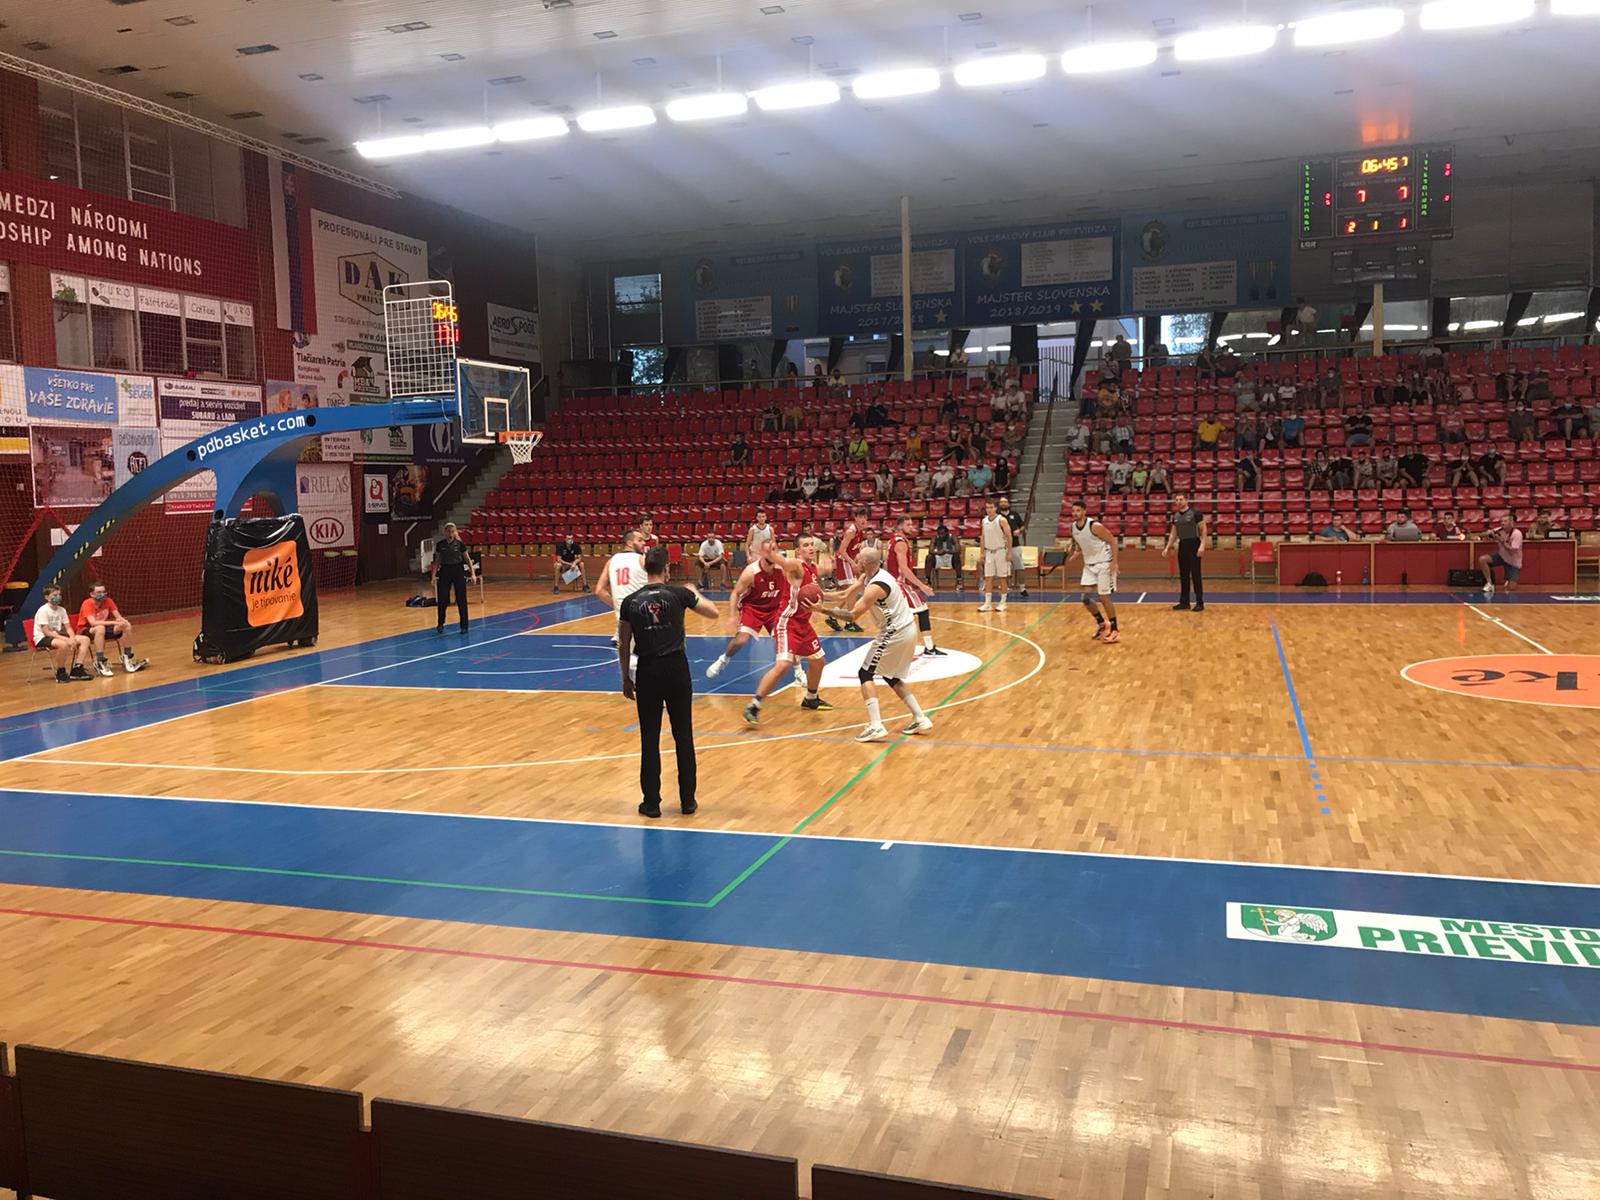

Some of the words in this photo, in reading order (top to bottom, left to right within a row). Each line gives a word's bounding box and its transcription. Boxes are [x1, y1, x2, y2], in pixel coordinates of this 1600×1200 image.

[1361, 157, 1398, 174] 06:45
[1357, 190, 1366, 203] 7
[1399, 186, 1408, 200] 7
[0, 192, 55, 220] MEDZI
[71, 204, 149, 240] NÁRODMI
[1347, 221, 1357, 233] 2
[1373, 220, 1379, 231] 1
[67, 233, 128, 262] AMONG
[140, 248, 202, 276] NATIONS
[378, 237, 394, 249] PRE
[395, 241, 423, 256] STAVBY
[344, 261, 405, 296] DAK
[977, 291, 1033, 305] MAJSTER
[1036, 286, 1111, 301] SLOVENSKA
[830, 302, 882, 315] MAJSTER
[989, 304, 1061, 318] 2018/2019
[857, 314, 925, 327] 2017/218
[327, 357, 346, 367] Patria
[47, 373, 79, 390] VŠETKO
[29, 388, 62, 407] VAŠE
[66, 397, 114, 415] ZDRAVIE
[191, 410, 216, 420] SUBARU
[222, 412, 236, 421] LADA
[197, 415, 306, 460] pdbasket.com
[315, 522, 339, 539] KIA
[250, 557, 293, 594] niké
[615, 567, 630, 586] 10
[768, 581, 775, 590] 6
[260, 593, 297, 609] tipovanie
[1440, 919, 1600, 944] MESTO
